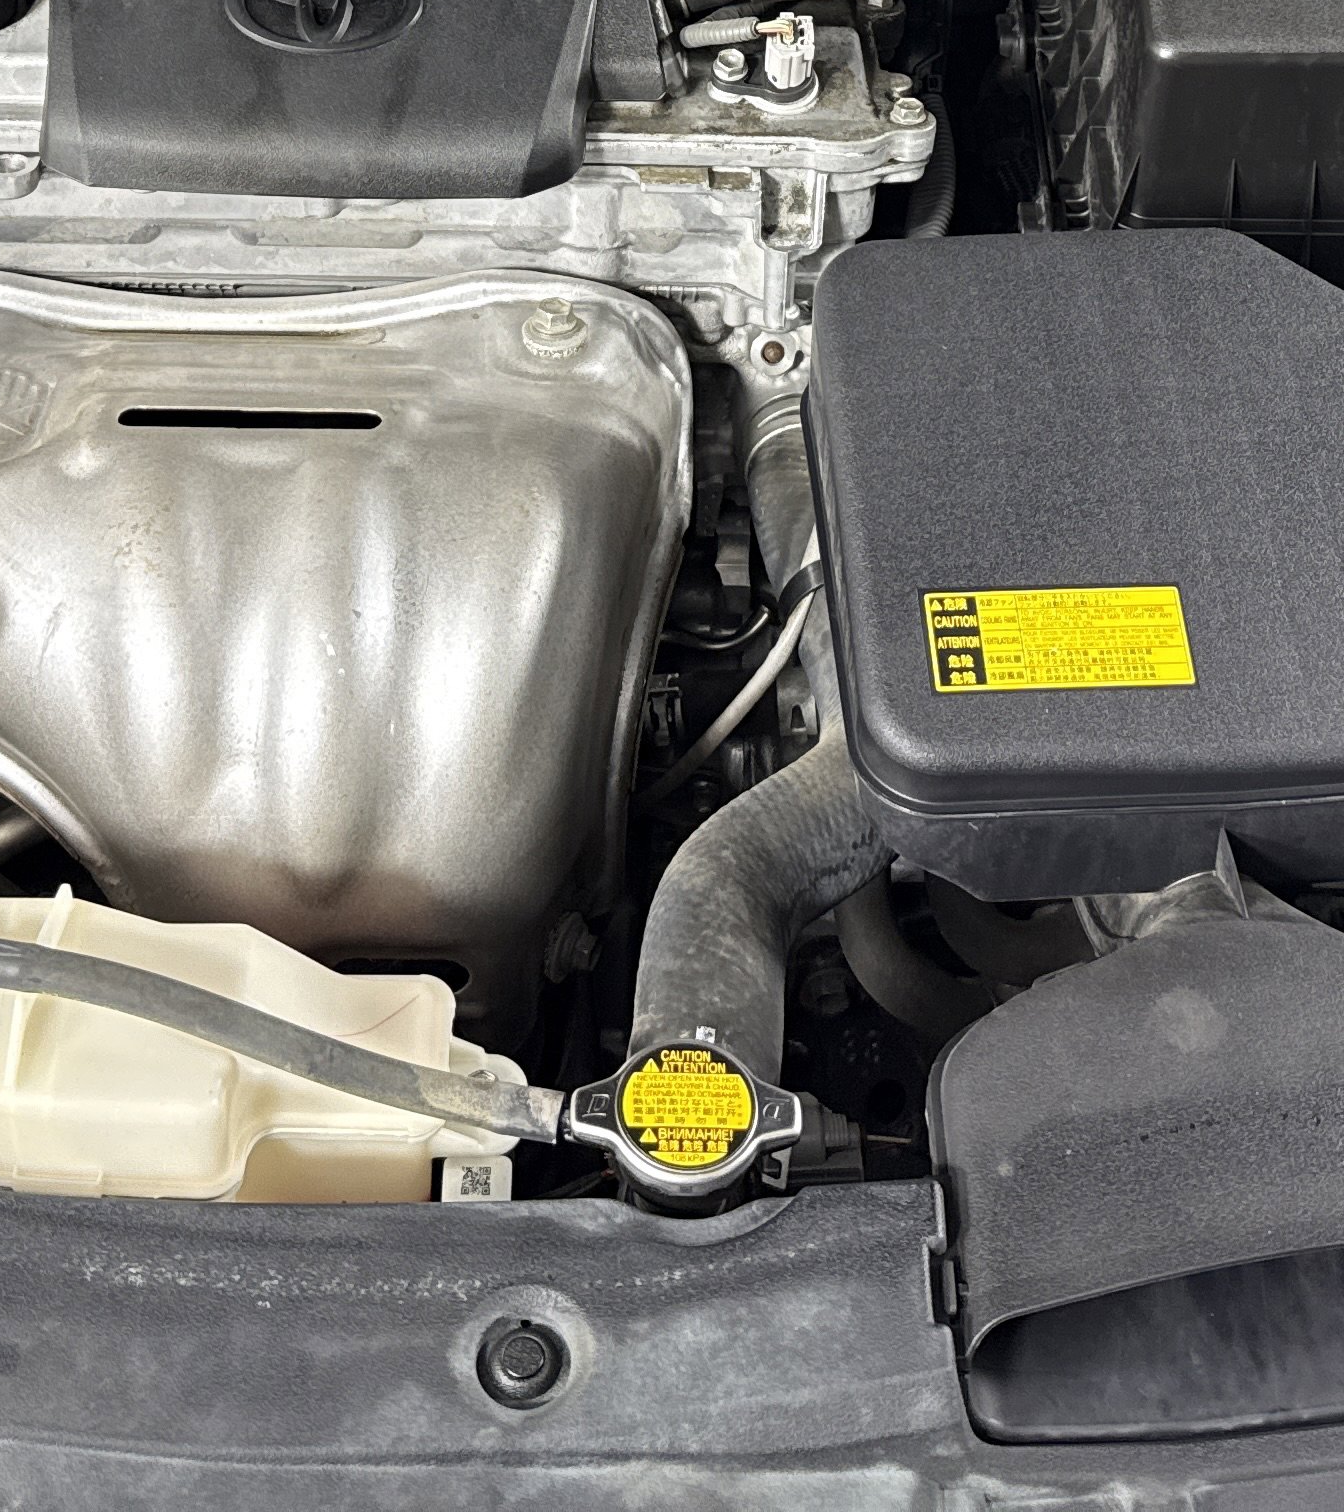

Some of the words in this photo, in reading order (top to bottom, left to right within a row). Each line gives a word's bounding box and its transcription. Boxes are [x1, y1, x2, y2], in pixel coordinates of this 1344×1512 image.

[933, 614, 978, 629] CAUTION
[937, 635, 981, 650] ATTENTION
[660, 1049, 712, 1063] CAUTION
[660, 1062, 727, 1074] ATTENTION
[636, 1074, 666, 1082] NEVER
[667, 1074, 692, 1082] OPEN
[694, 1075, 720, 1083] WHEN
[645, 1082, 673, 1090] JAMAIS
[657, 1128, 735, 1145] ВНИМАНИЕ!
